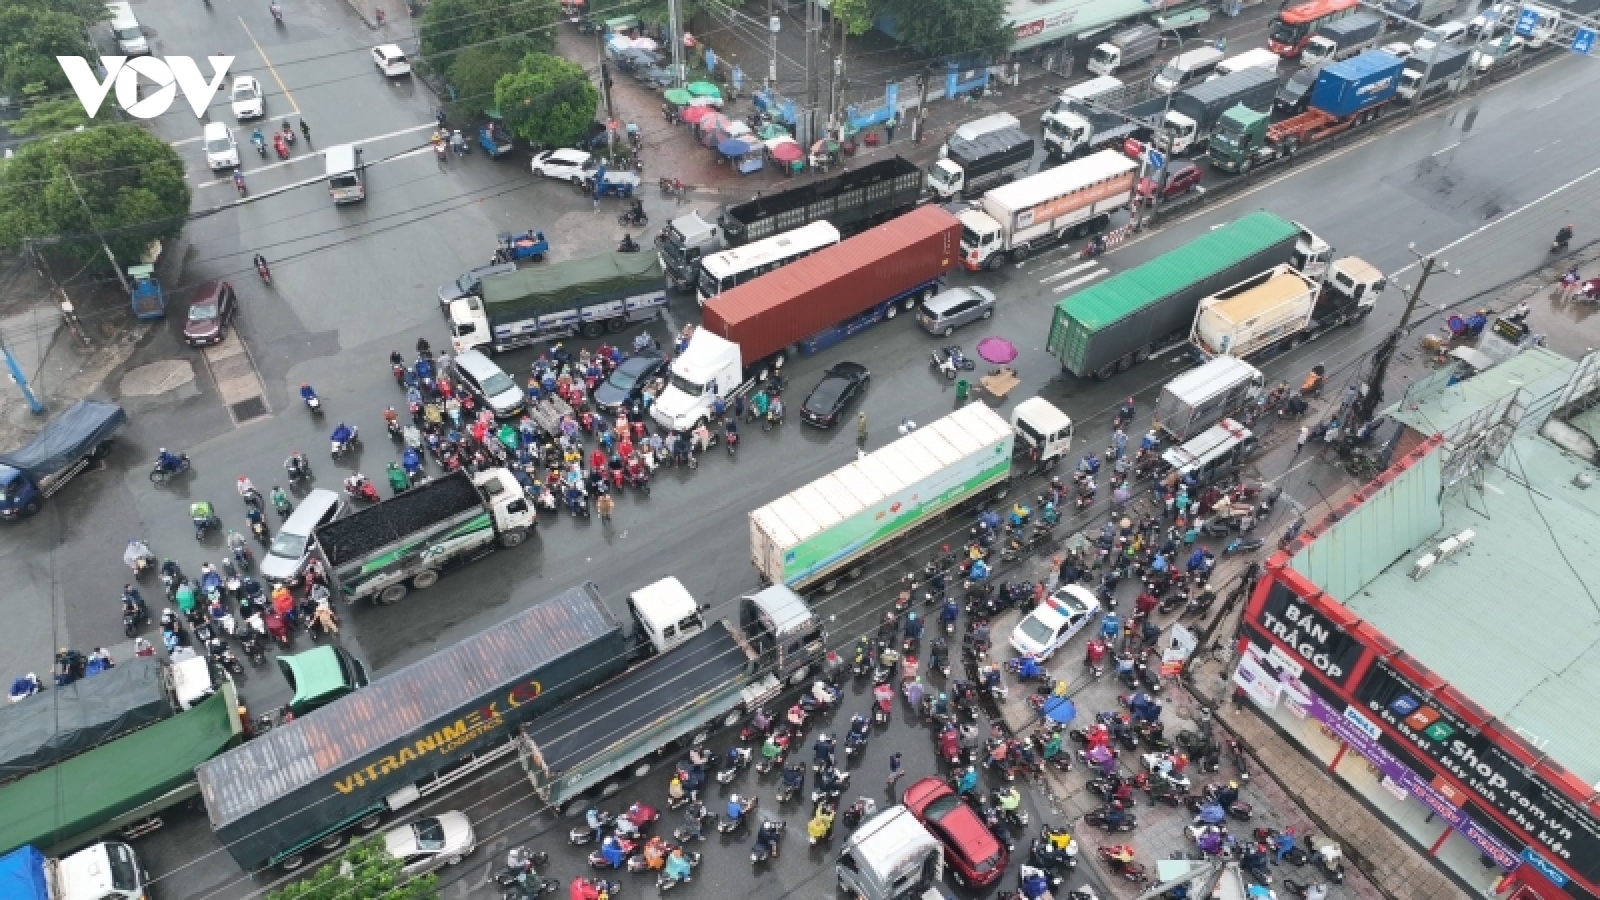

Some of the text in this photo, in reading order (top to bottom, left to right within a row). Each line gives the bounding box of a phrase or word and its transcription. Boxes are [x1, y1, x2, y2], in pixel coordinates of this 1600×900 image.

[1285, 604, 1330, 644] BÁN
[1369, 699, 1396, 724] Đện
[333, 701, 503, 795] VITRANIMEX
